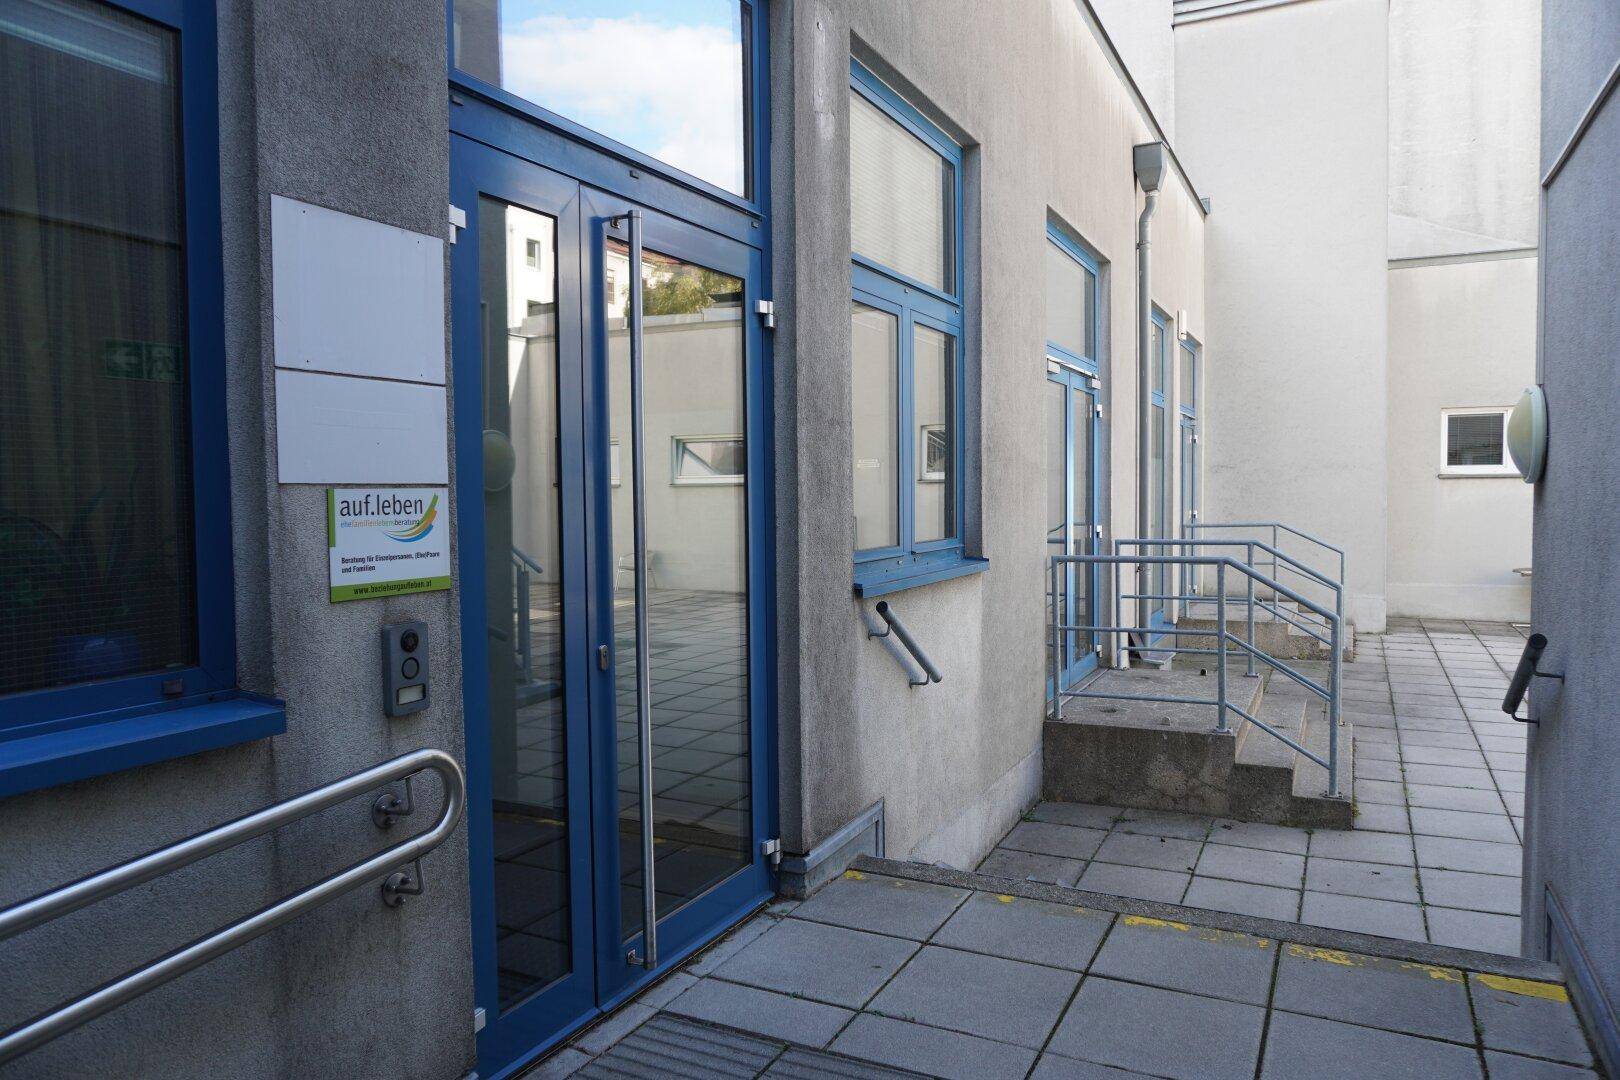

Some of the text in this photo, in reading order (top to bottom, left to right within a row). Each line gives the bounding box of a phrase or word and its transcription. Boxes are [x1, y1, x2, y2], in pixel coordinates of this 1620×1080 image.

[340, 494, 422, 516] auf.leben
[341, 556, 366, 564] Beratung
[341, 565, 376, 574] und Familien
